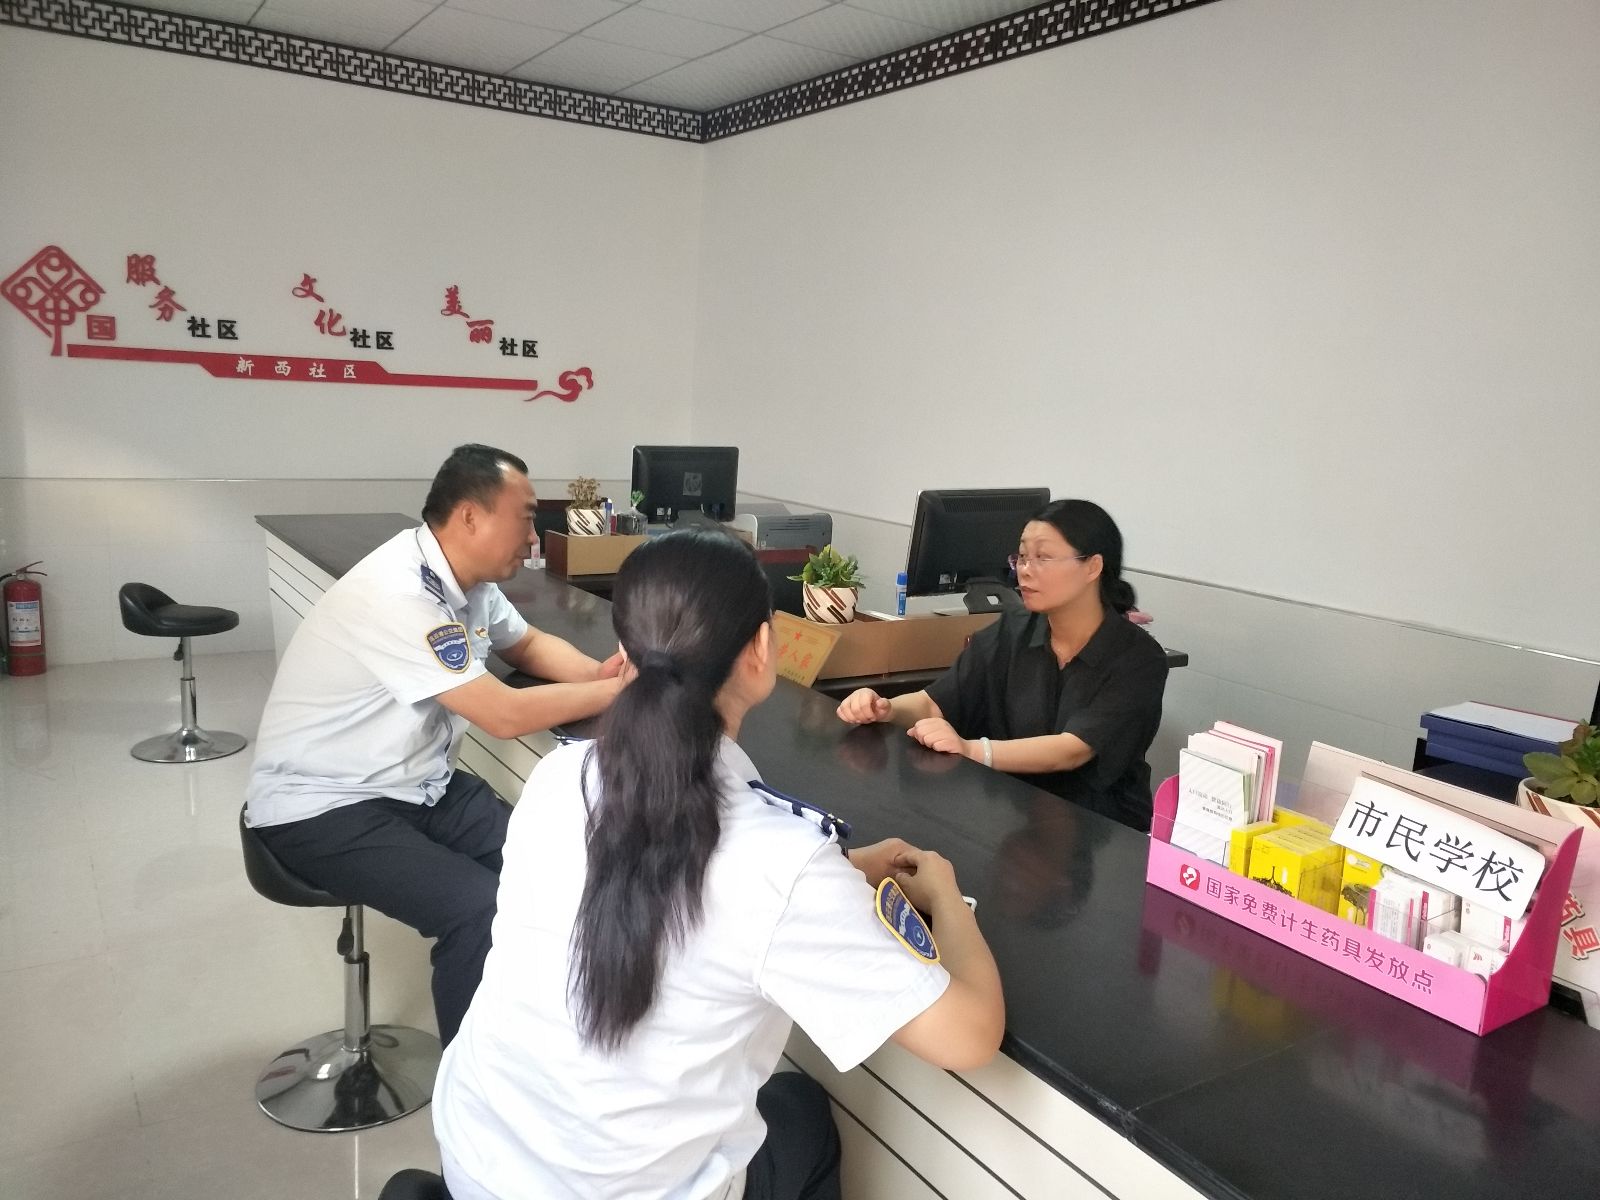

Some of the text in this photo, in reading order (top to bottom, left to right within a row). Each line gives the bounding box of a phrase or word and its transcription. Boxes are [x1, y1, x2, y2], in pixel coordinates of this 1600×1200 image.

[236, 356, 356, 379] 新西社区
[1348, 801, 1523, 901] 市民学校
[1206, 876, 1434, 994] 国家免费计生药具发放点
